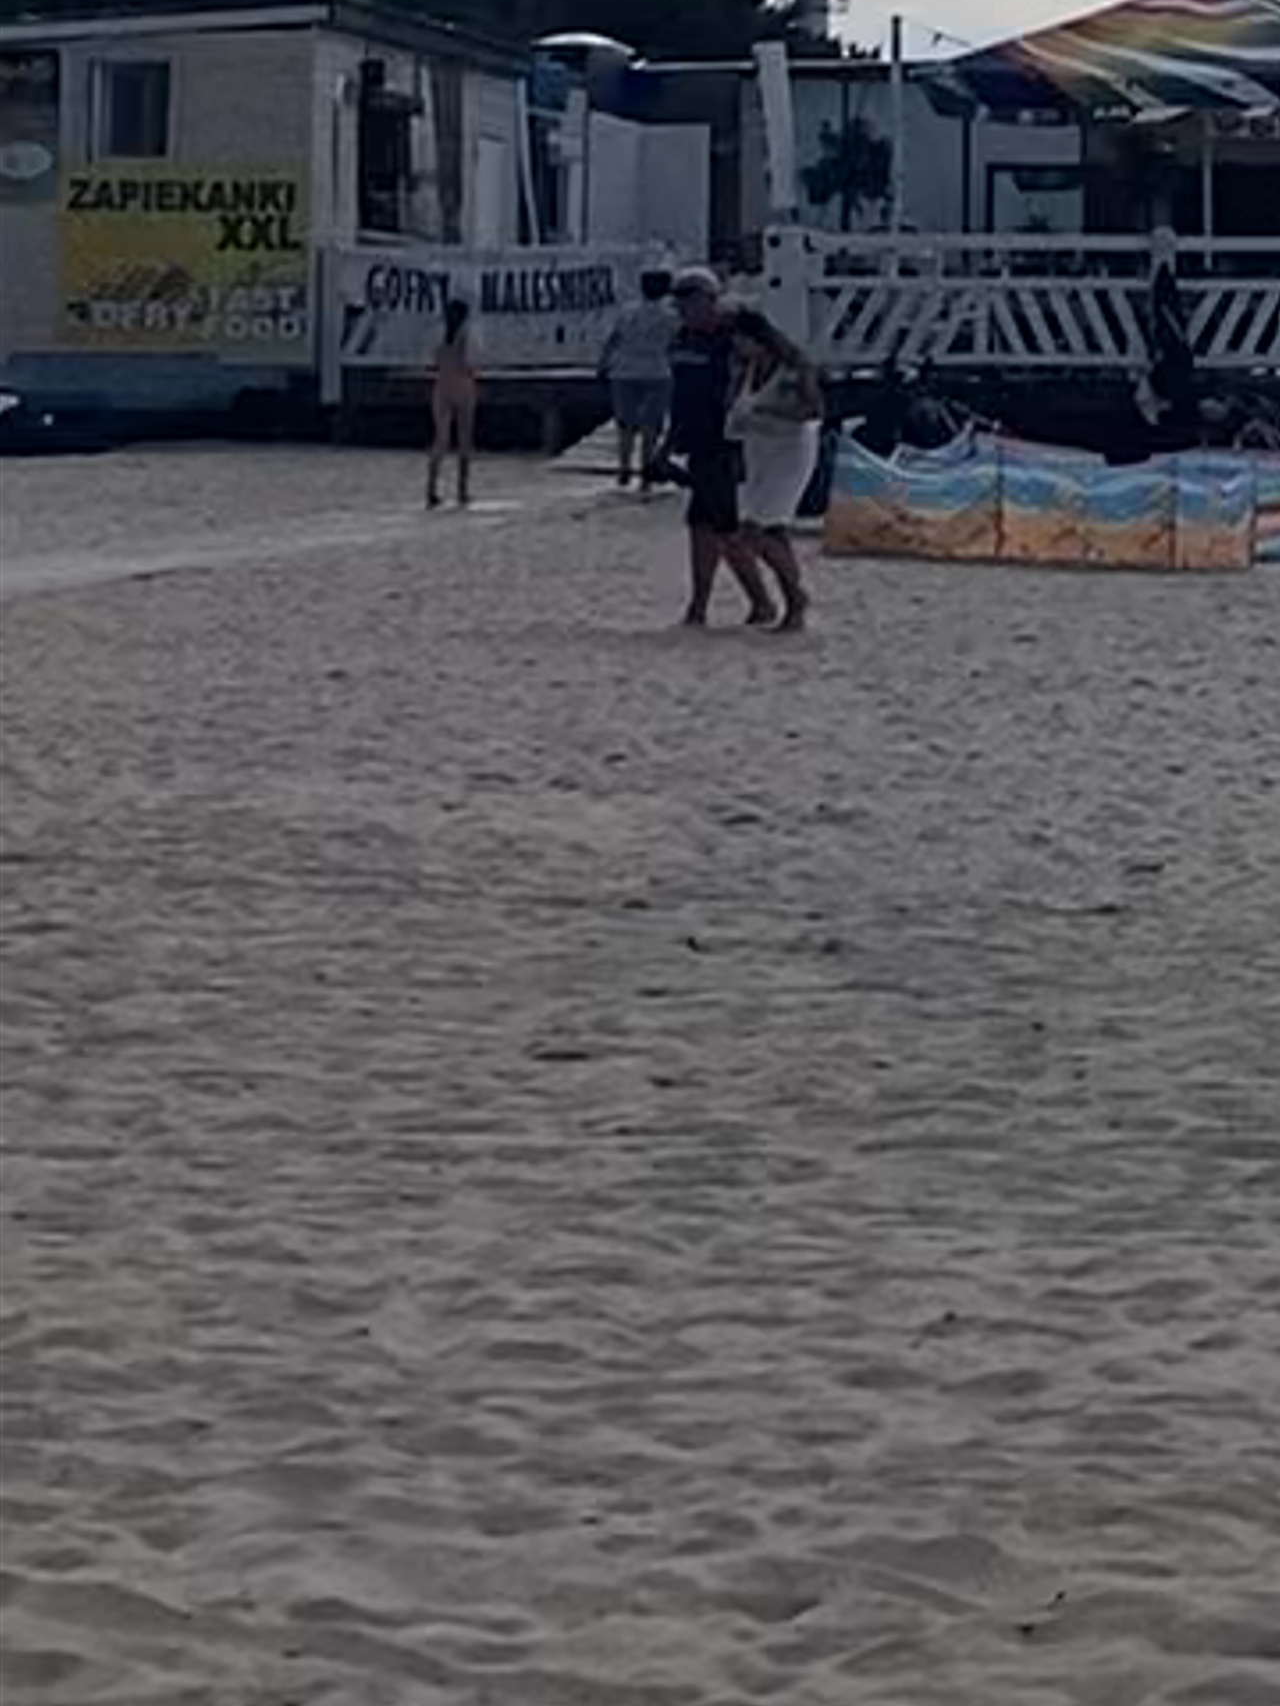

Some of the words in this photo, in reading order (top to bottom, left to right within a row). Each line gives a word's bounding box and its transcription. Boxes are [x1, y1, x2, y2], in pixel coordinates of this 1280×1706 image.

[67, 178, 297, 213] ZAPIEKANKI
[217, 214, 302, 251] XXL
[365, 263, 450, 313] GOFRY
